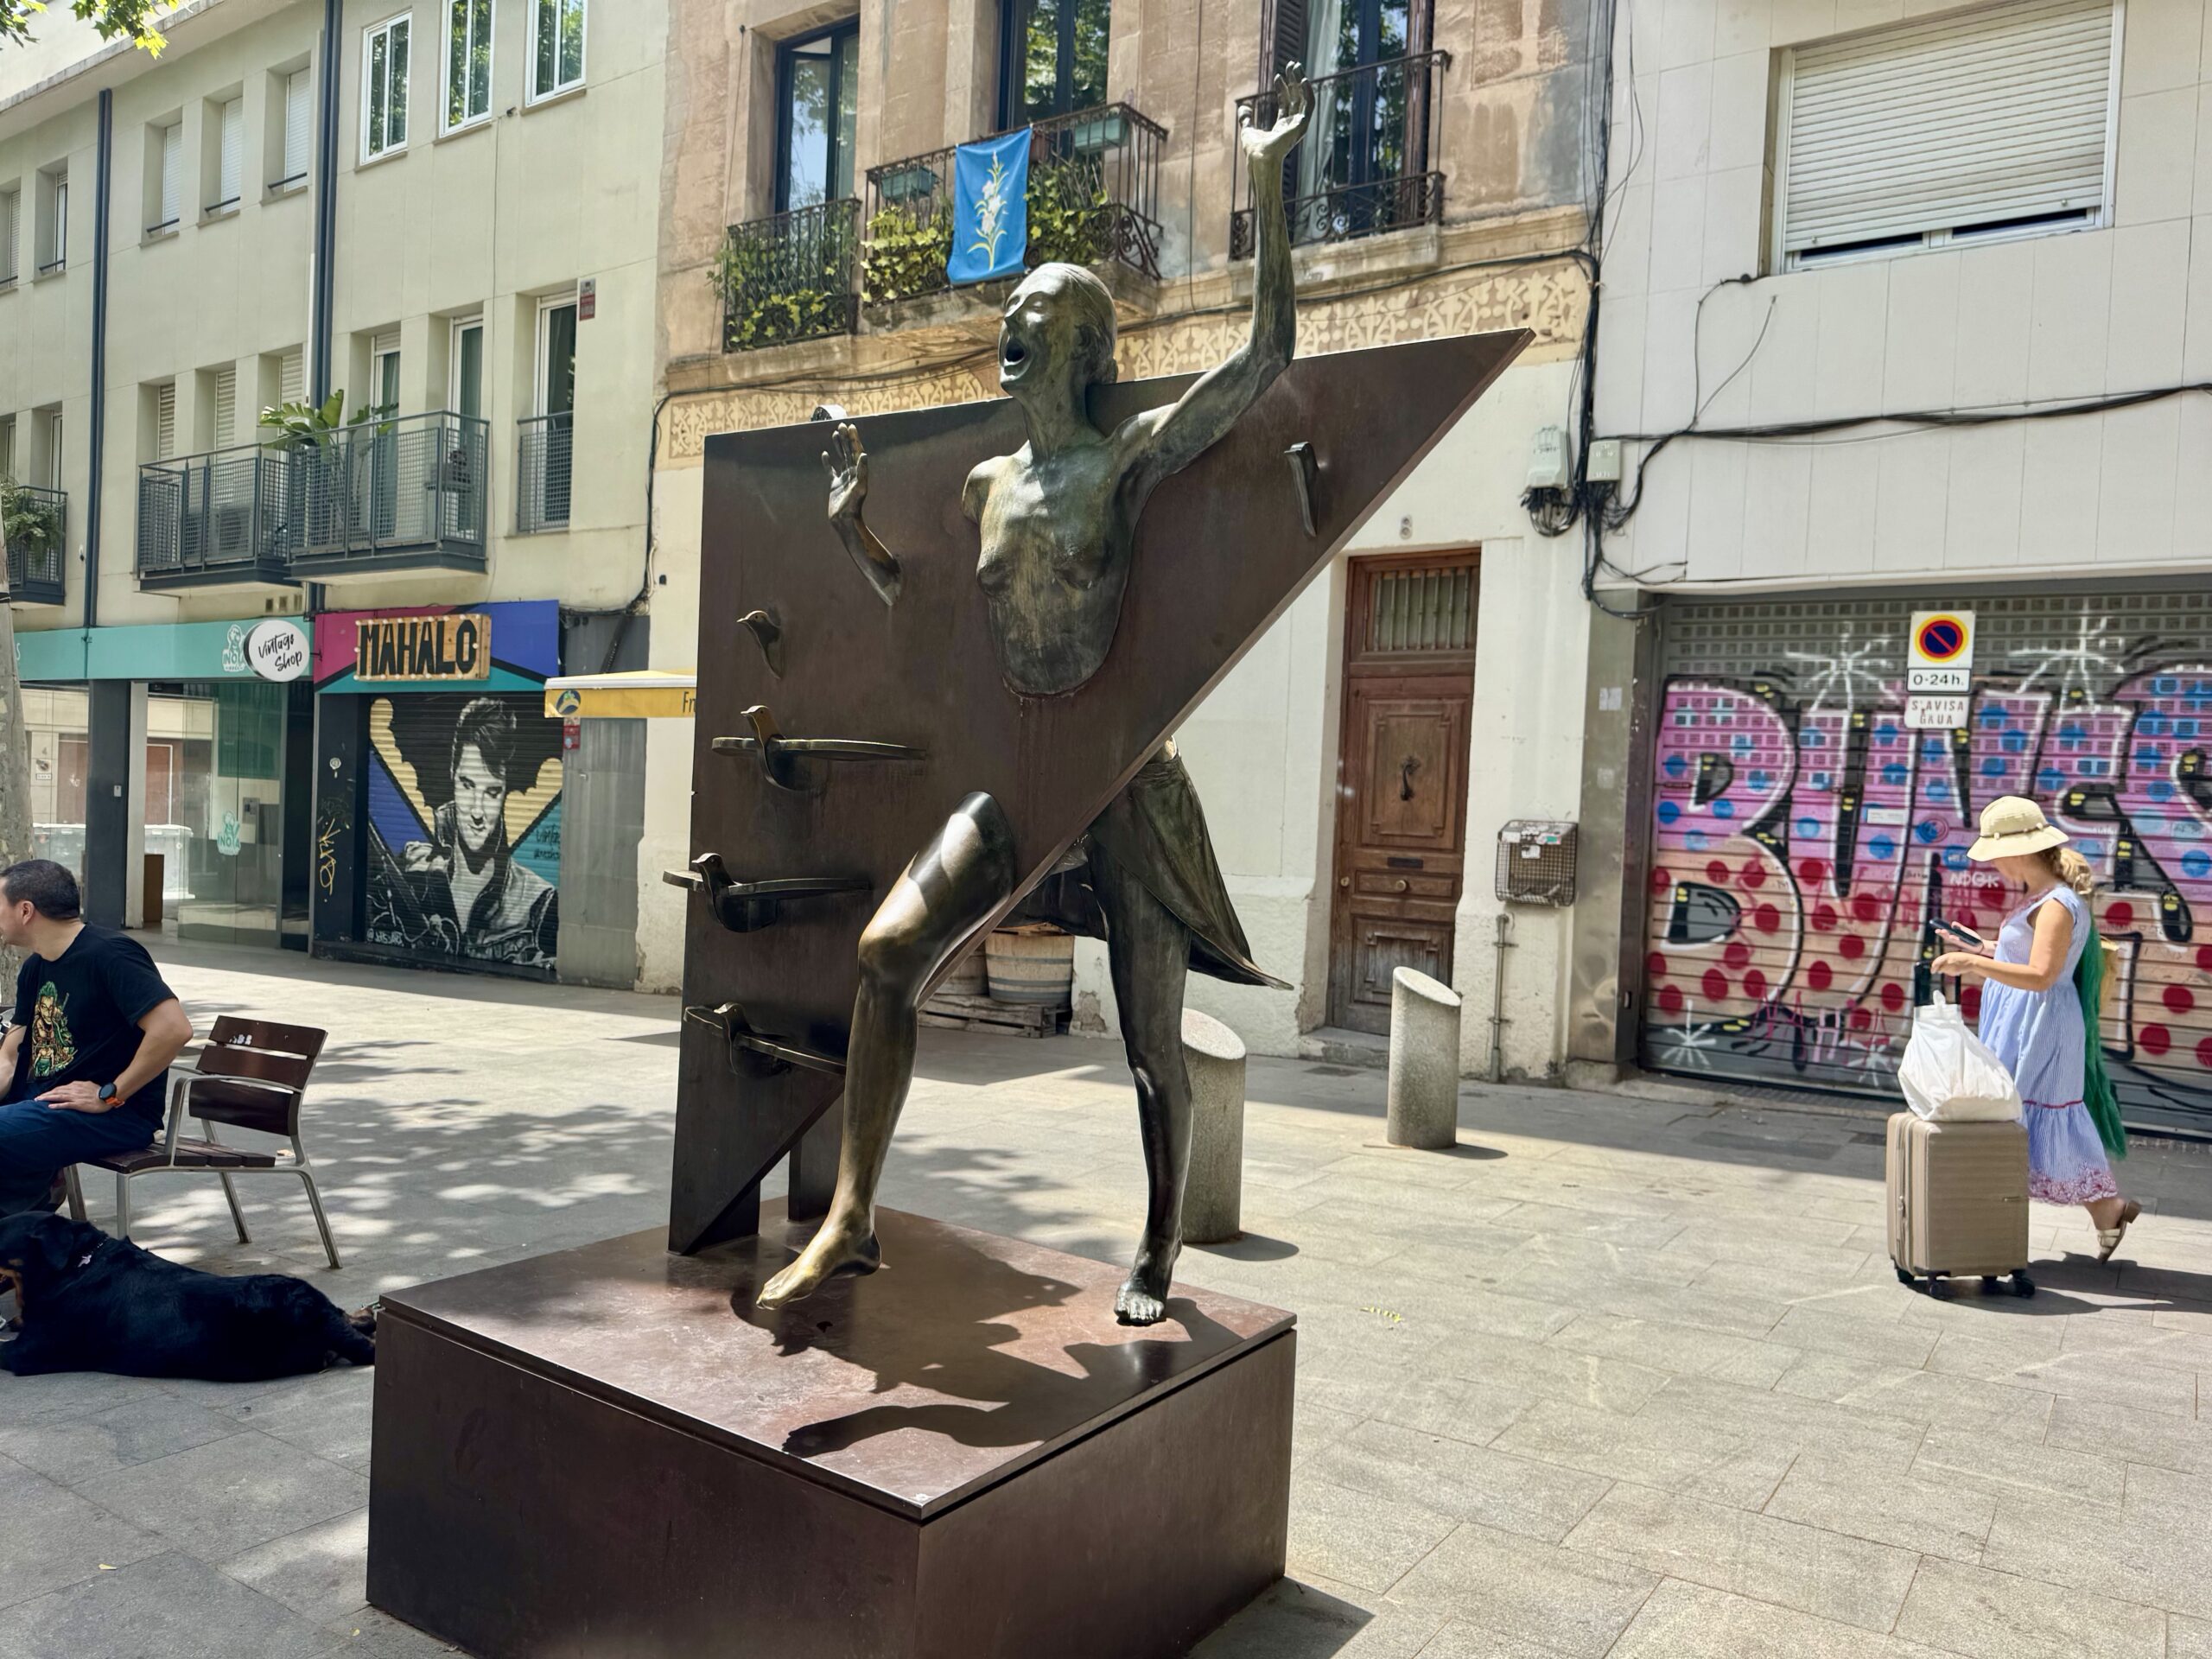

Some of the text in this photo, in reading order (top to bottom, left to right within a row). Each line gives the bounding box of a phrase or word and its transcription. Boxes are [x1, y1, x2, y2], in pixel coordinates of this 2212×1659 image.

[257, 632, 295, 659] Vintage
[359, 619, 477, 676] MAHALO
[274, 651, 303, 672] Shop
